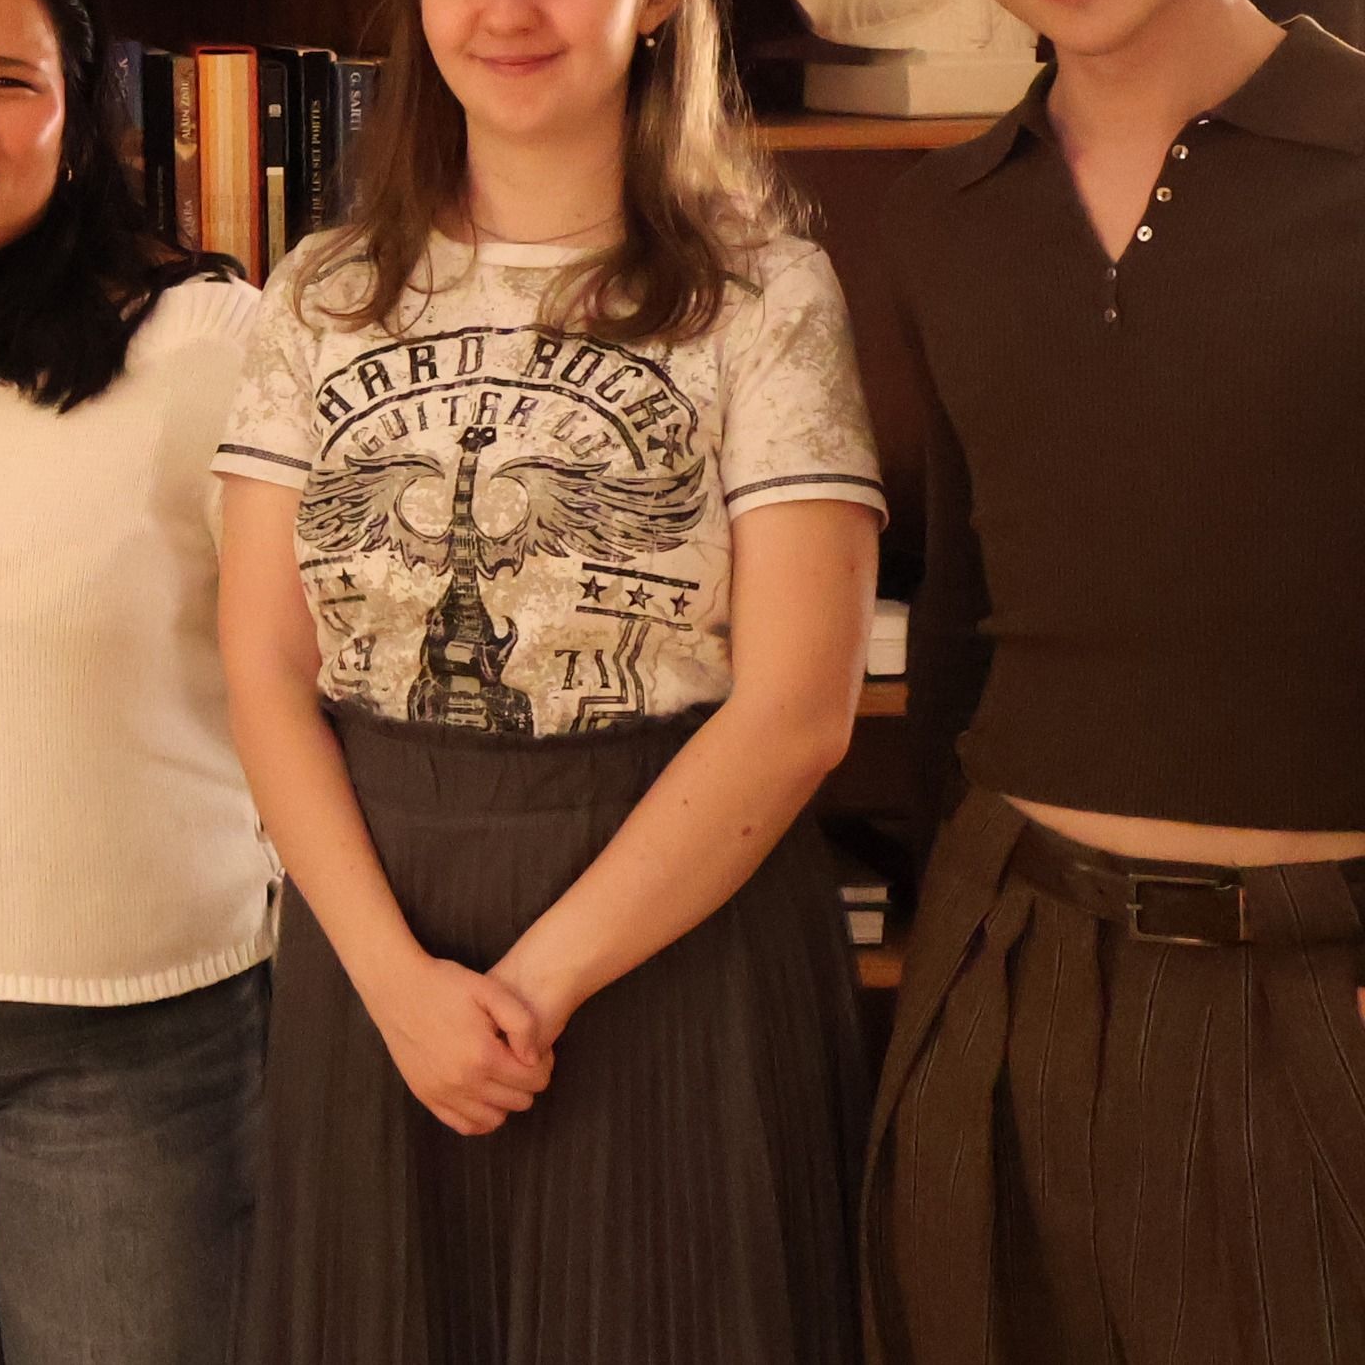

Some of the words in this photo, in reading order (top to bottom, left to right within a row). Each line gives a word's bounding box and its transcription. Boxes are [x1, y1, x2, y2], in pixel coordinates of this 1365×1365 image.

[318, 336, 484, 425] HARD
[520, 335, 679, 432] ROCK
[352, 391, 539, 456] GUITAR
[554, 649, 612, 691] 71
